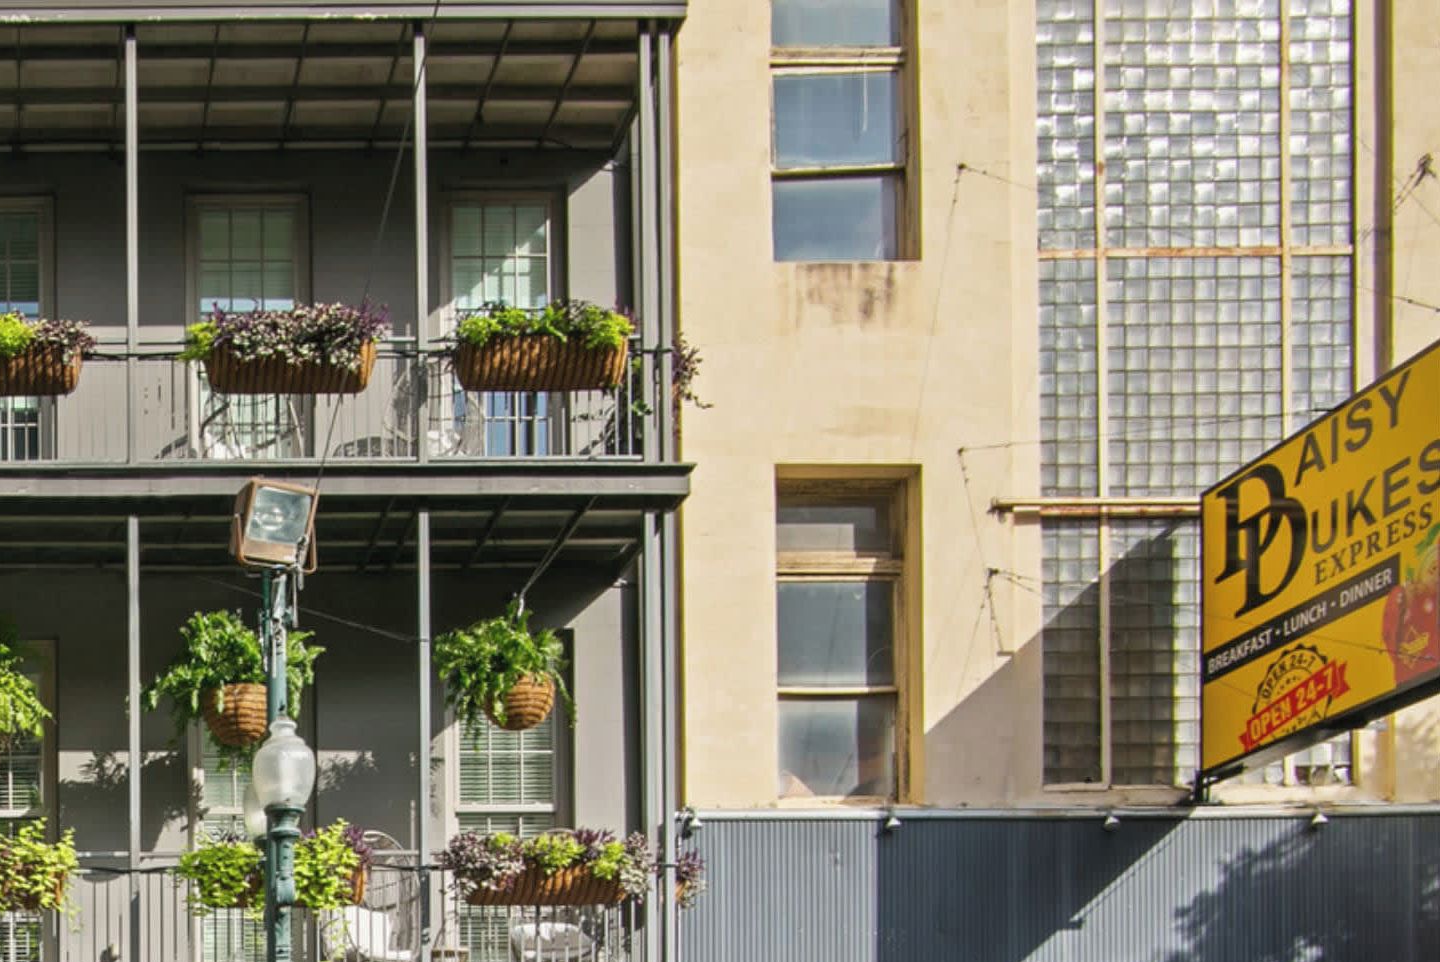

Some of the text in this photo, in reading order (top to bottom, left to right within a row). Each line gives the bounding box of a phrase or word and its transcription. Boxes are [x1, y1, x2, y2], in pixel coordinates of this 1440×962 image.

[1313, 502, 1433, 586] EXPRESS
[1207, 567, 1393, 673] BREAKFAST LUNCH DINNER
[1250, 696, 1293, 740] OPEN
[1296, 667, 1333, 711] 24-7
[1261, 660, 1287, 699] OPEN
